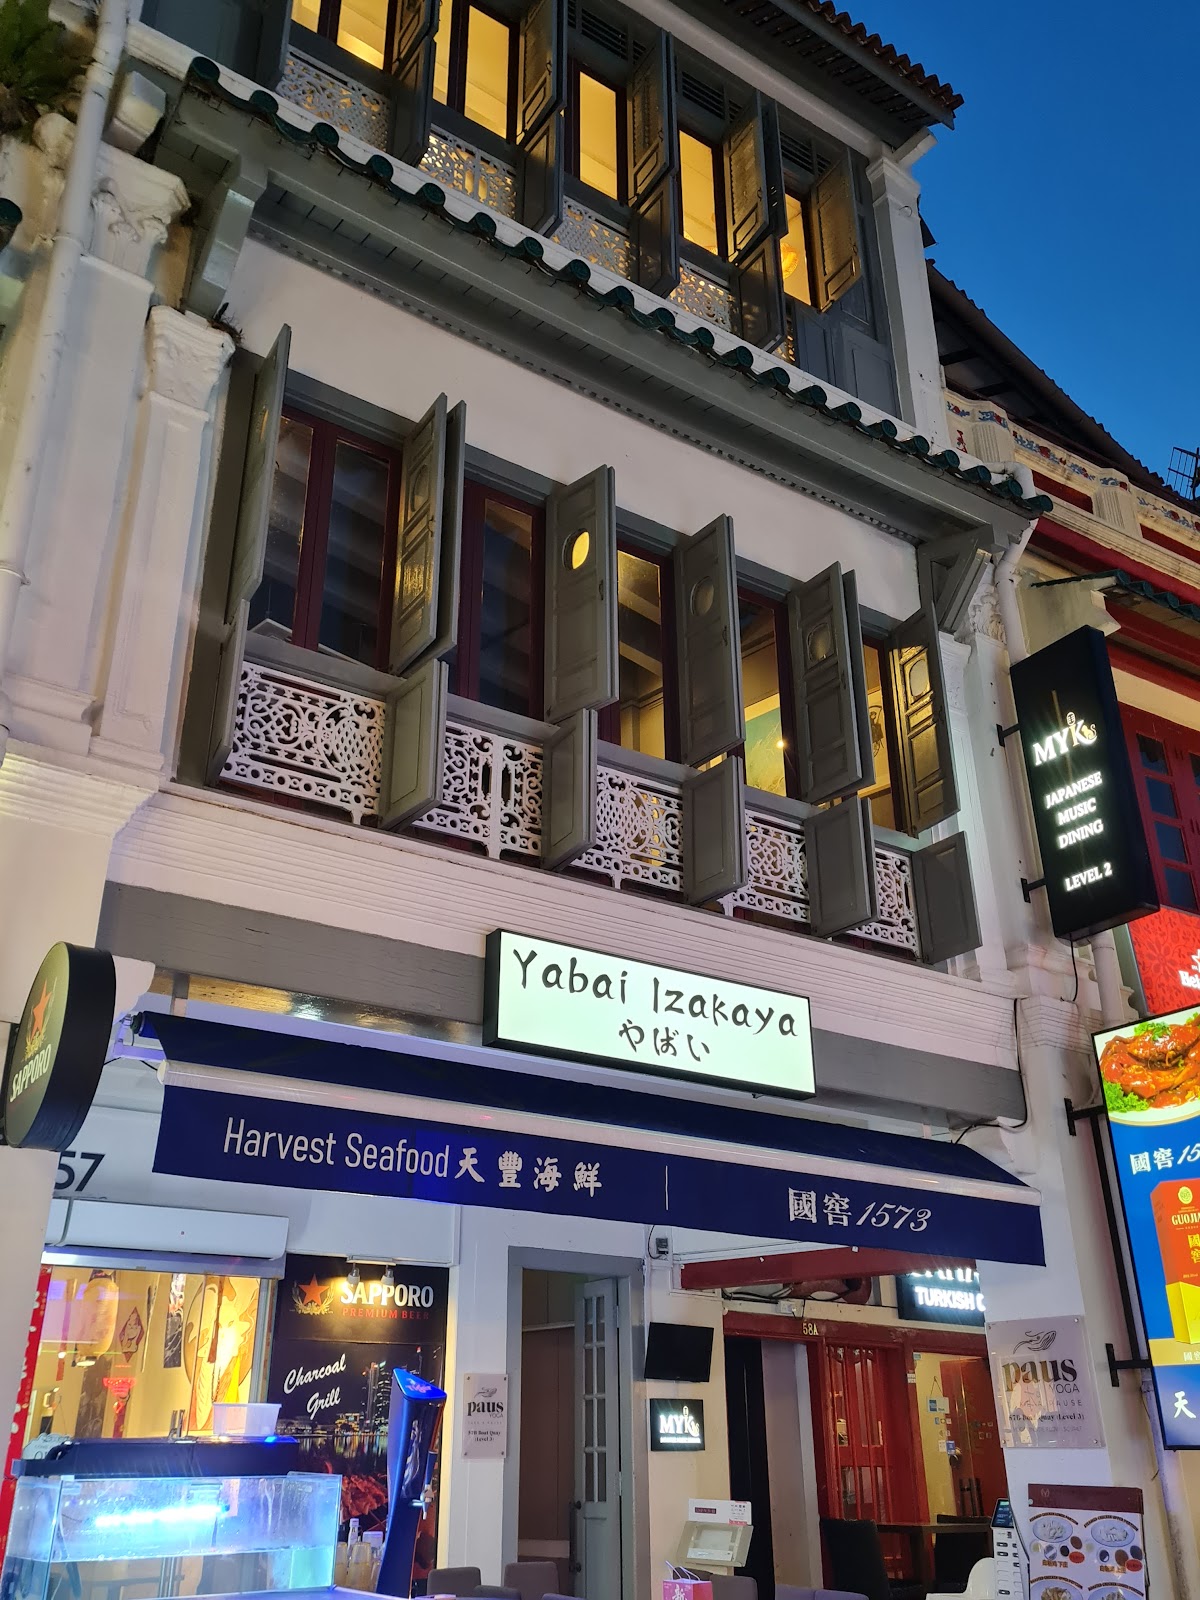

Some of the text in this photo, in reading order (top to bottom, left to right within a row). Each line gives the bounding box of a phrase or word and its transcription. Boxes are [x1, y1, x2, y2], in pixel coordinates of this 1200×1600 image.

[1045, 771, 1103, 809] JAPANESE
[1058, 797, 1097, 826] MUSIC
[1058, 818, 1105, 849] DINING
[1065, 862, 1113, 892] LEVEL 2
[513, 949, 798, 1037] Yabai Izakaya
[618, 1018, 711, 1062] やばい
[10, 1043, 52, 1103] SAPPORO
[223, 1116, 450, 1178] Harvest Seafood
[54, 1151, 105, 1192] 57
[340, 1280, 434, 1308] SAPPORO
[914, 1286, 975, 1310] TURKISH
[342, 1307, 429, 1320] PREMIUM BEER
[802, 1322, 818, 1335] 58A
[283, 1353, 347, 1394] Charcoal
[1002, 1359, 1077, 1392] paus
[1049, 1383, 1080, 1394] YOGA
[306, 1387, 341, 1420] Grill
[467, 1401, 504, 1416] paus
[1174, 1391, 1196, 1419] 天
